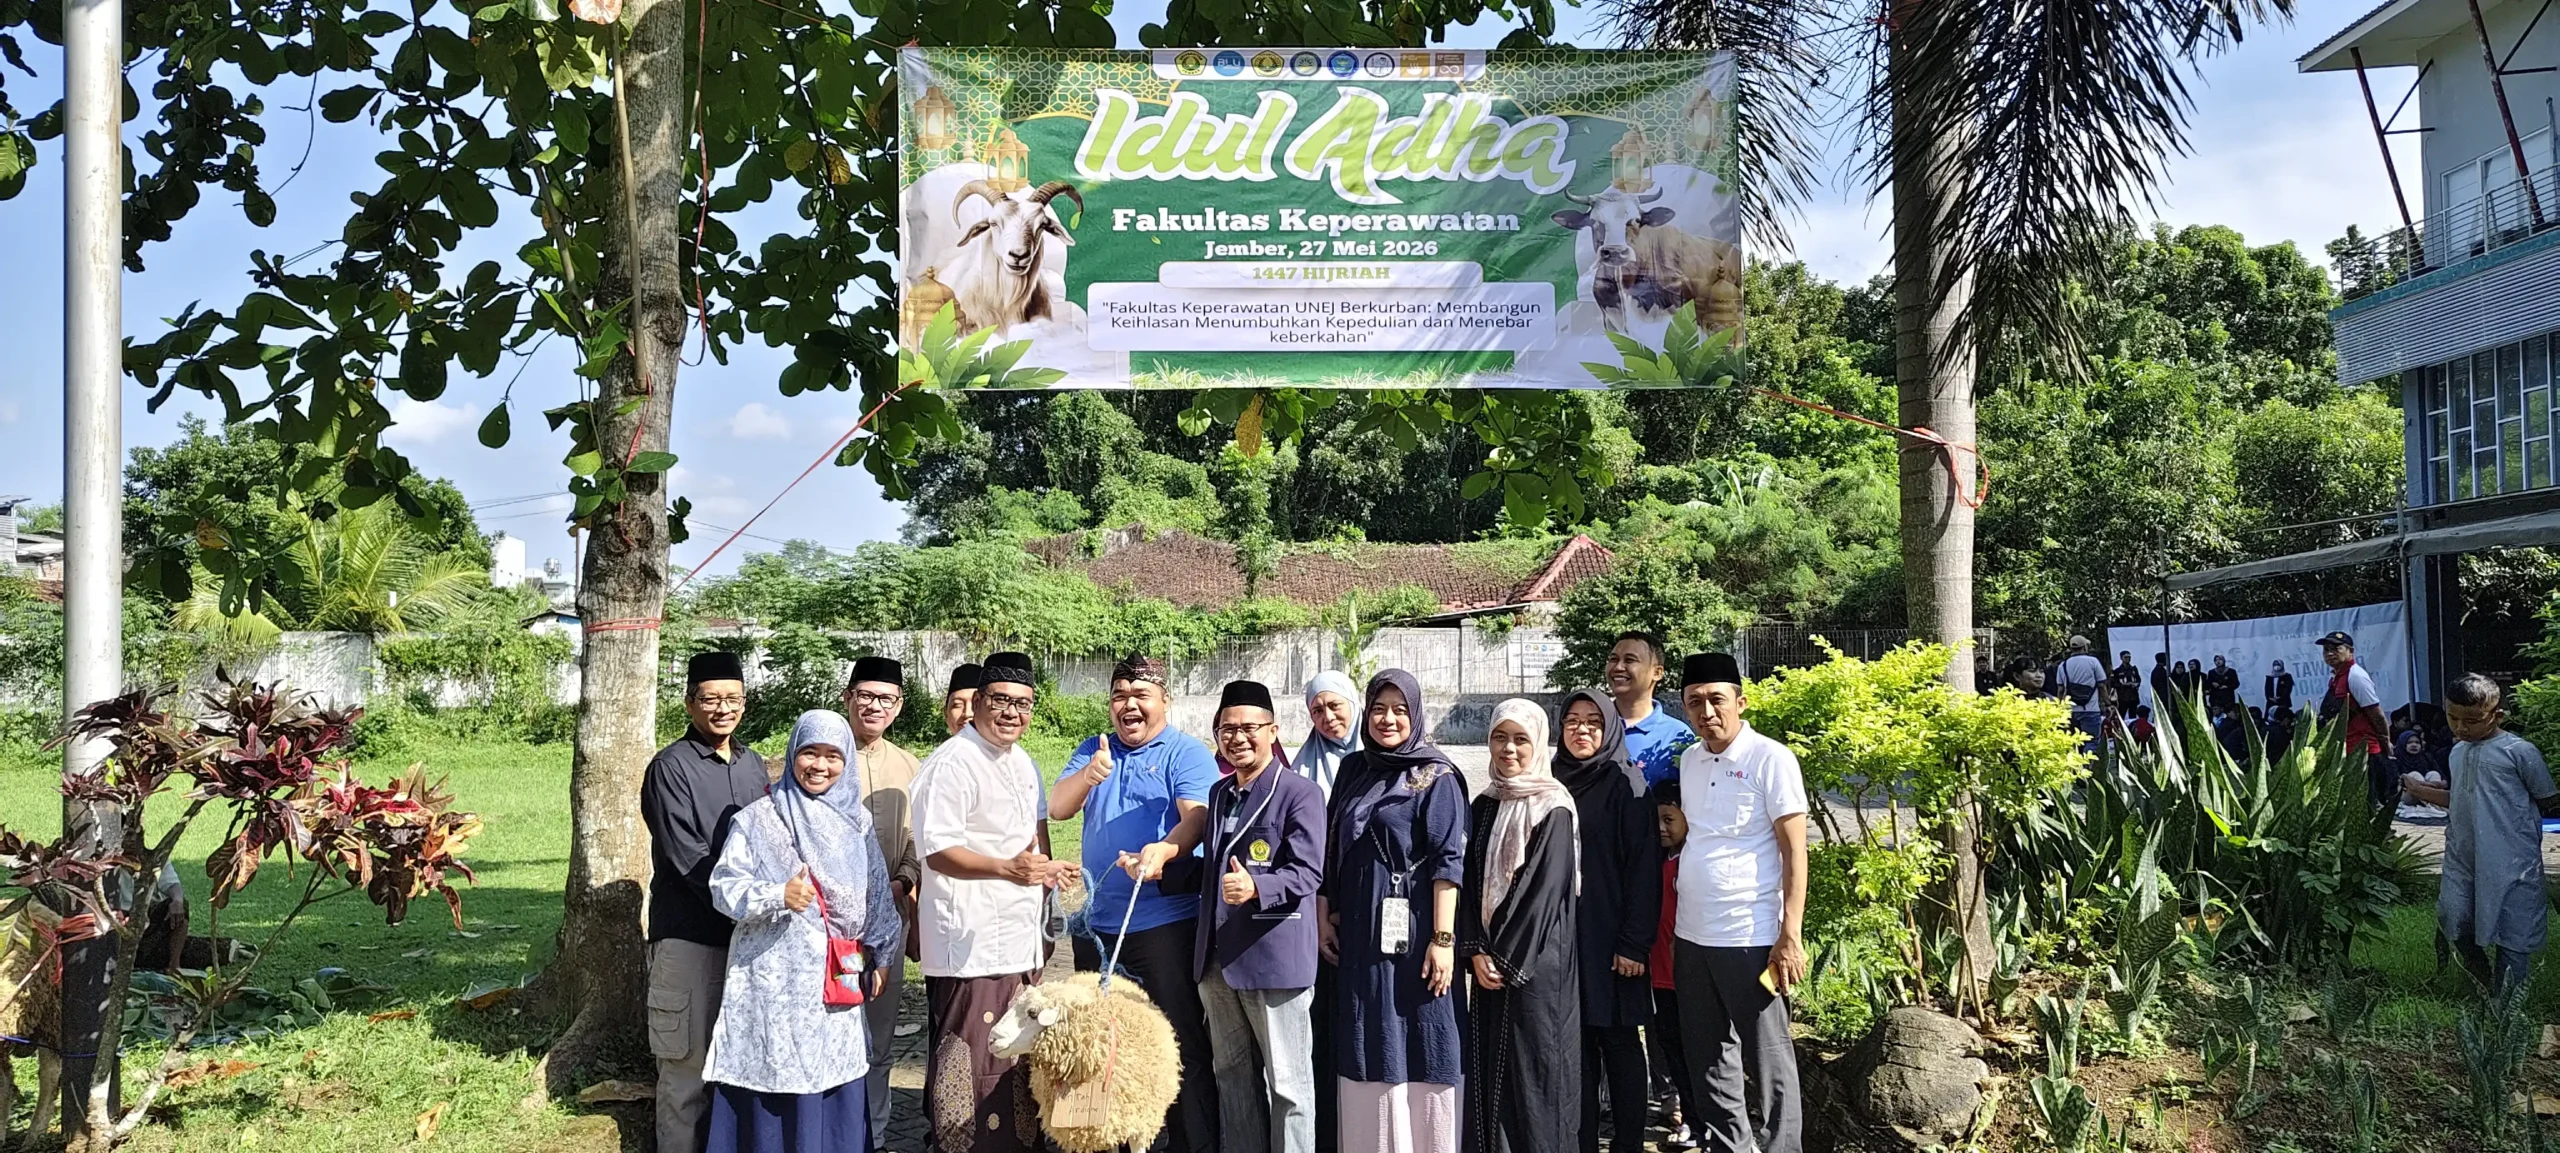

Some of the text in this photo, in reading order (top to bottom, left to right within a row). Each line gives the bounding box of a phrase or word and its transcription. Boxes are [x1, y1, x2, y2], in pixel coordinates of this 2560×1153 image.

[1075, 87, 1576, 204] Idul Adha
[1112, 207, 1520, 237] Fakultas Keperawatan
[1204, 240, 1439, 259] Jember, 27 Mei 2026
[1252, 266, 1390, 282] 1447 HIJRIAH
[1102, 301, 1541, 317] "Fakultas Keperawatan UNEJ Berkurban: Membangun
[1111, 316, 1533, 331] Keihlasan Menumbuhkan Kepedulian dan Menebar
[1270, 330, 1374, 343] keberkahan"
